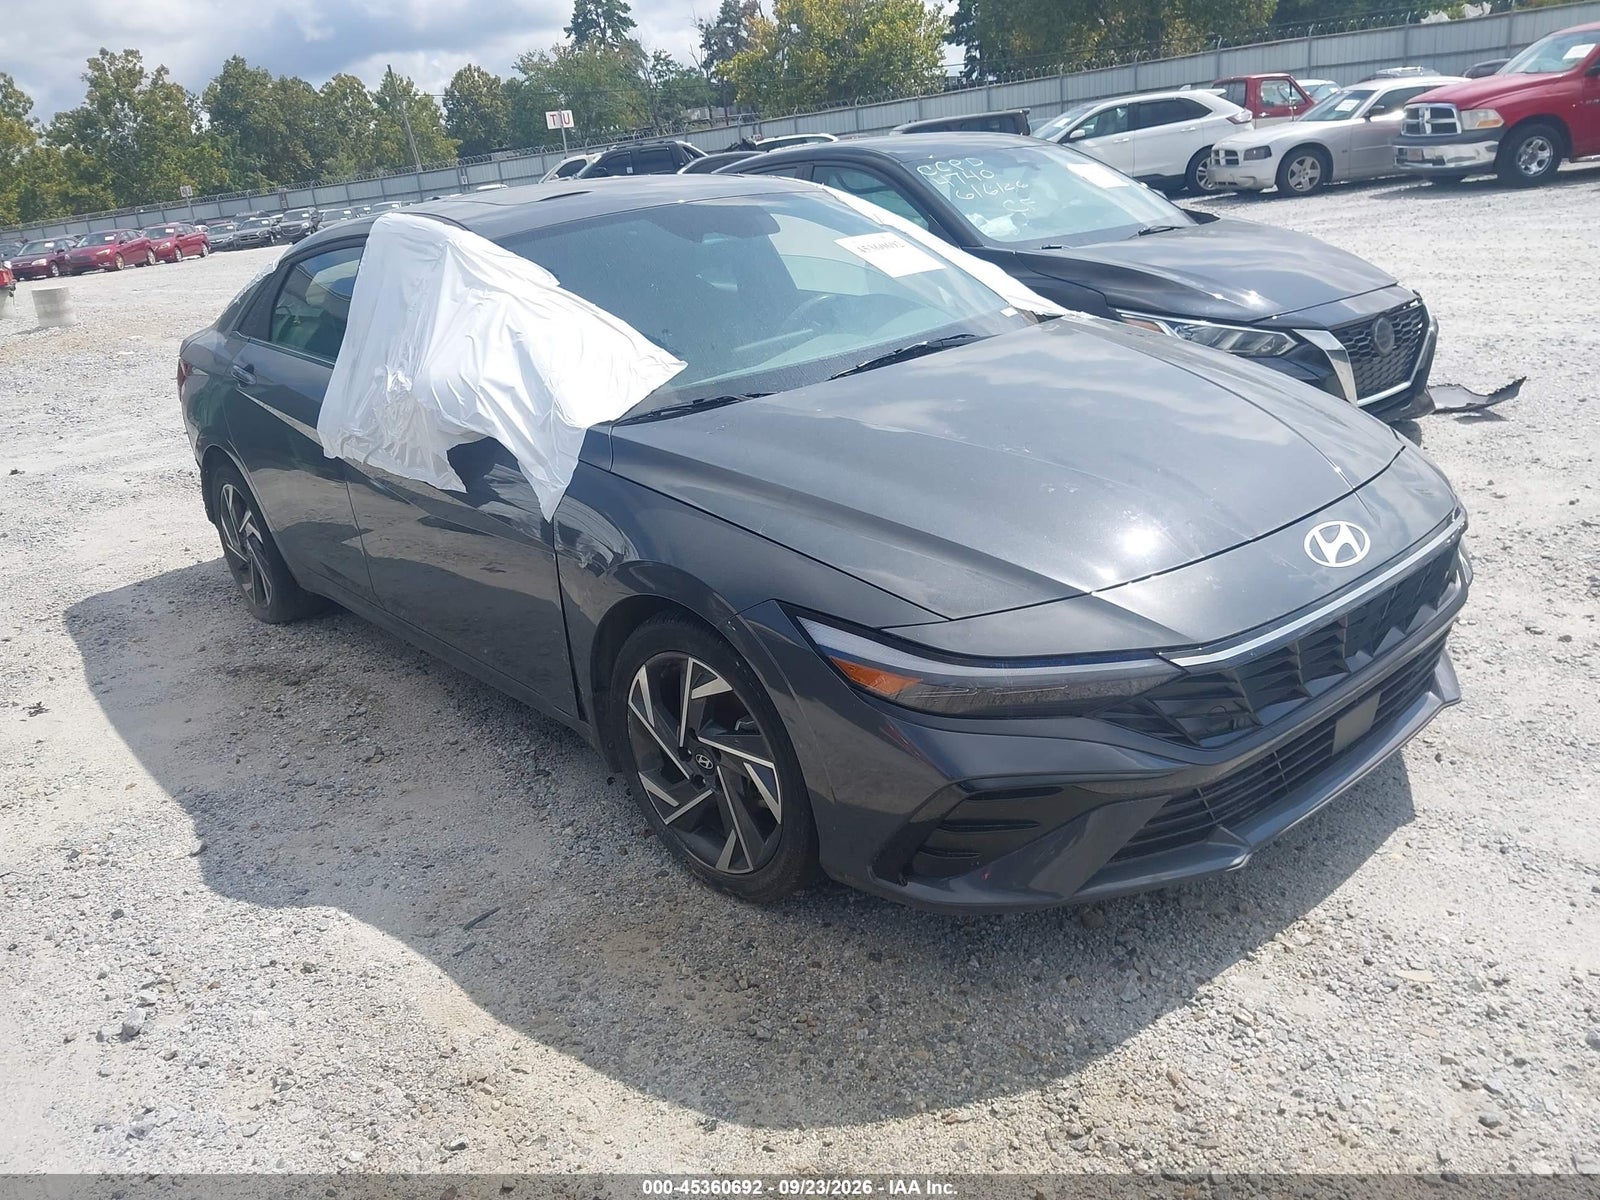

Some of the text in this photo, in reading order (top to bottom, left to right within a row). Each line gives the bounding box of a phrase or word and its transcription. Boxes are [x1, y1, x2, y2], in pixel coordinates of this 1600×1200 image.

[550, 113, 570, 126] T U
[933, 169, 995, 187] 4740
